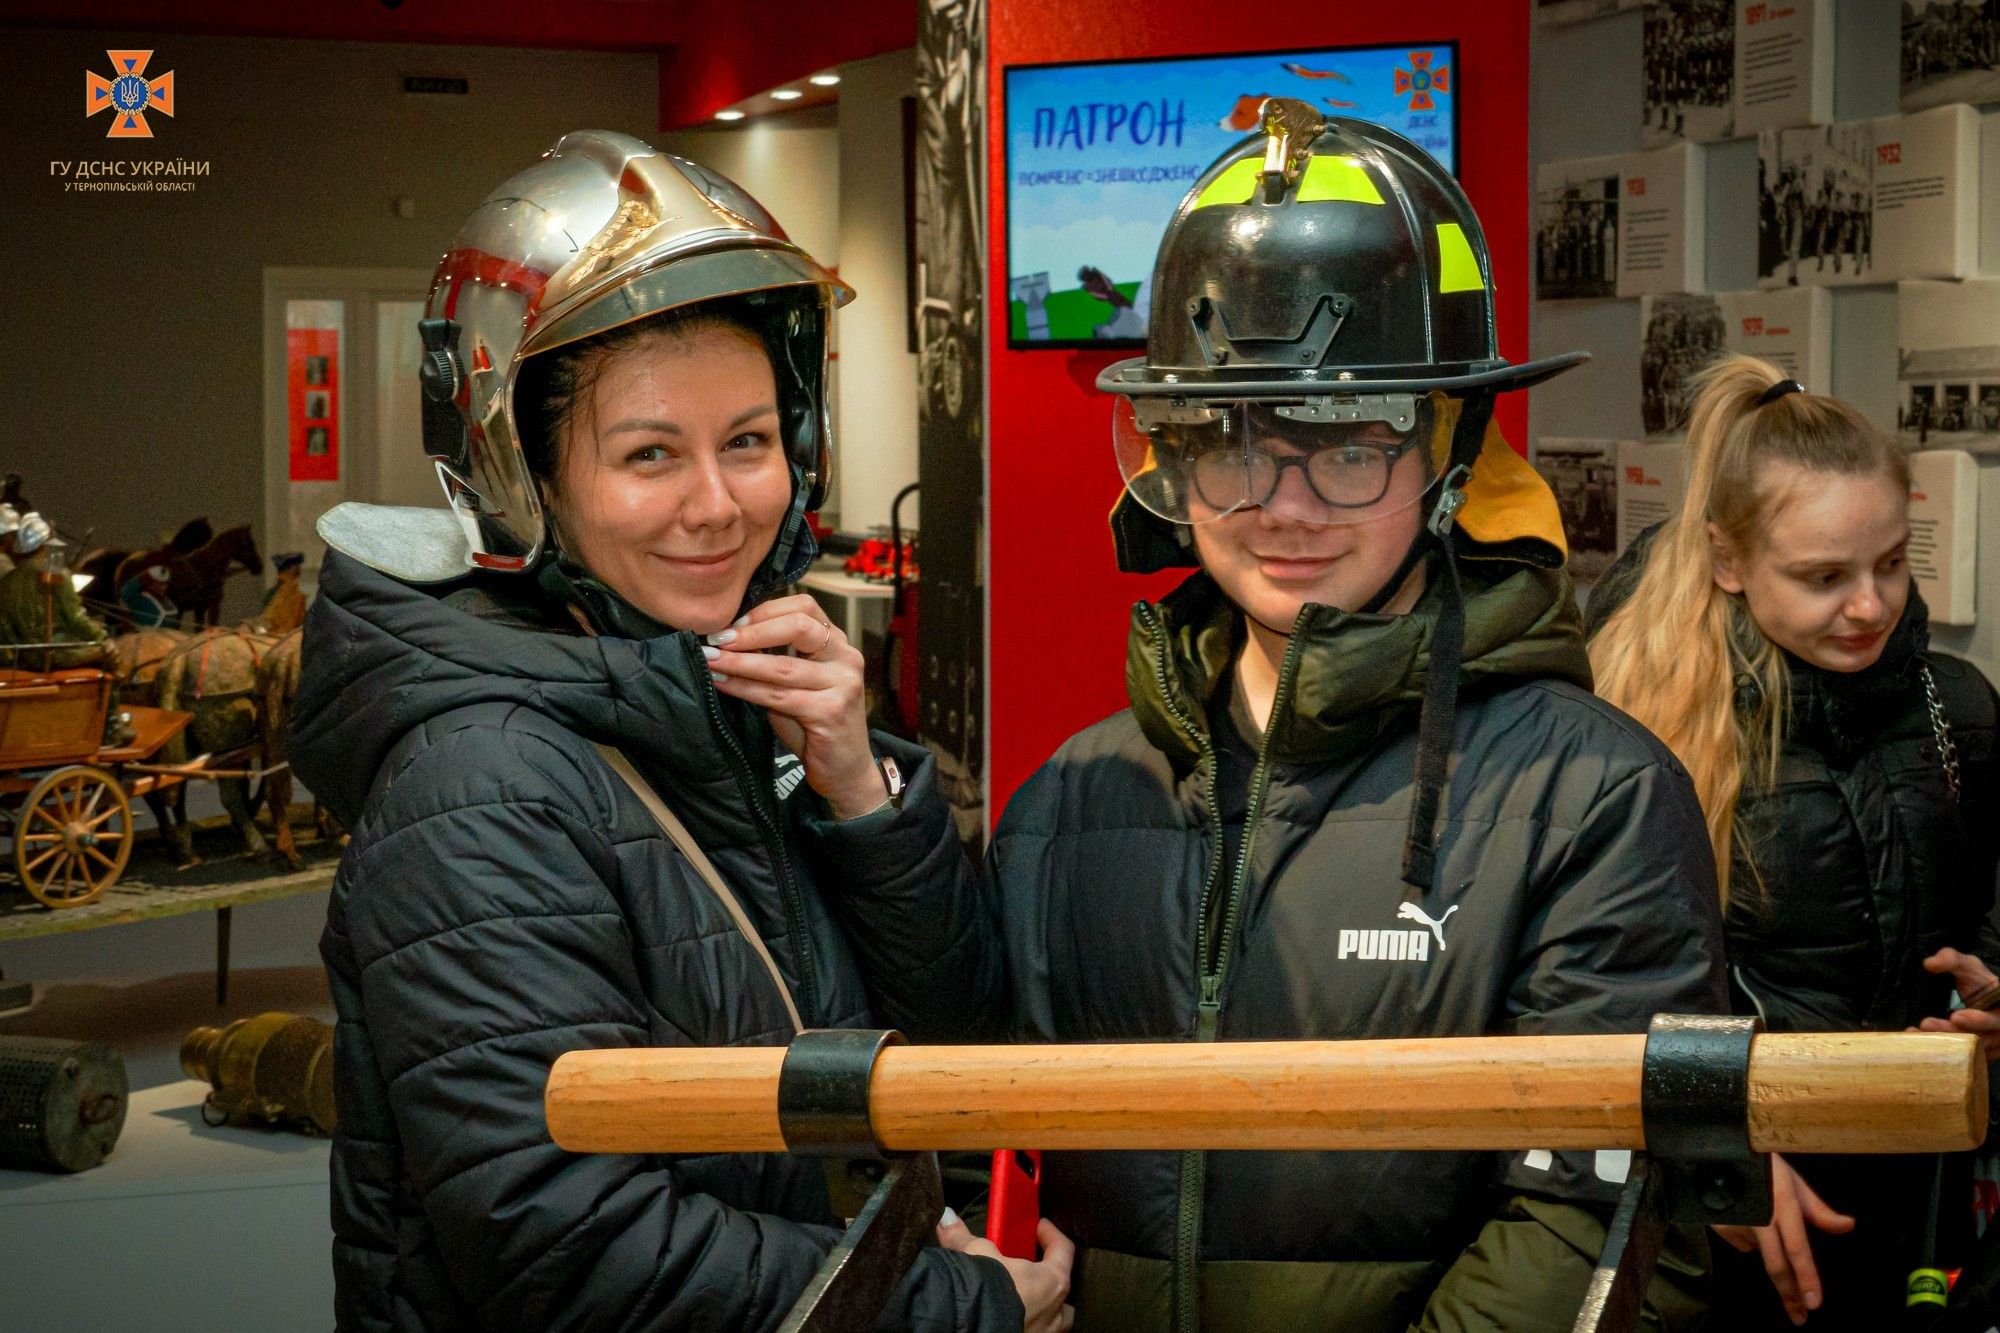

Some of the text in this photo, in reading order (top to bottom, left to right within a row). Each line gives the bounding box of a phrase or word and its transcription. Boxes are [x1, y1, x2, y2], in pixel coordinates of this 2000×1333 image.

[1034, 98, 1185, 150] ПАТРОН
[1876, 142, 1902, 166] 1932
[1338, 929, 1430, 961] PUMA
